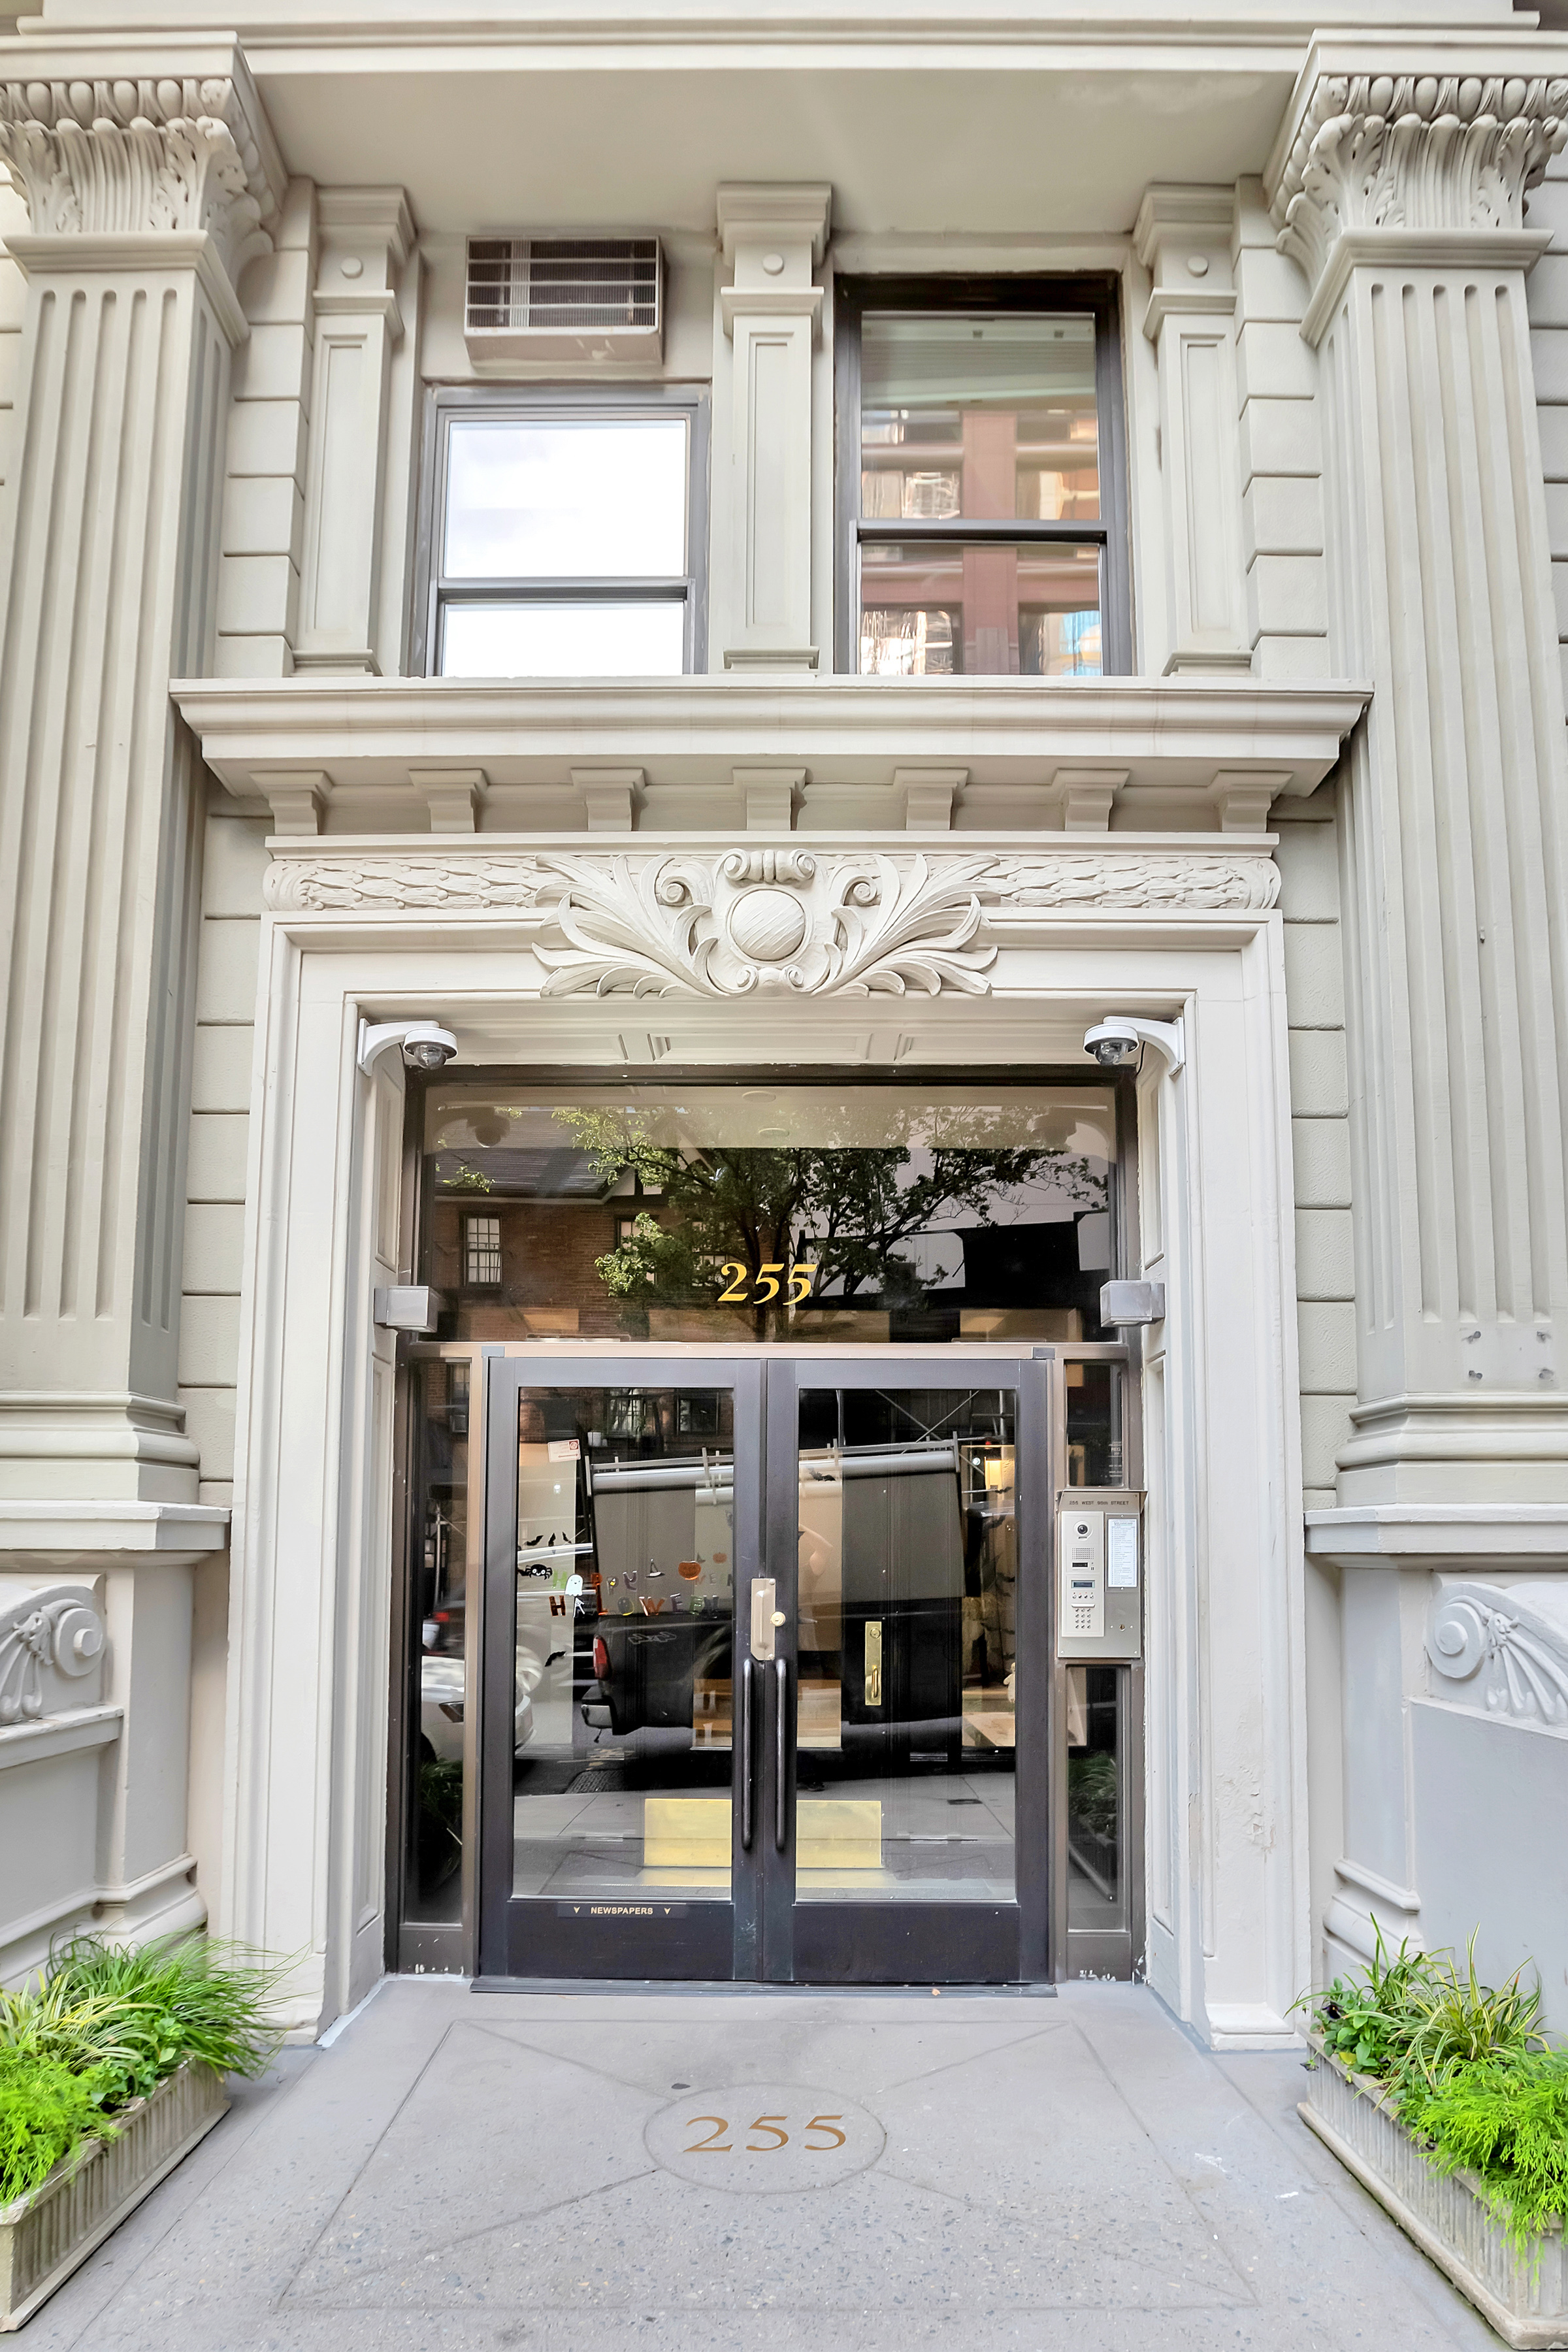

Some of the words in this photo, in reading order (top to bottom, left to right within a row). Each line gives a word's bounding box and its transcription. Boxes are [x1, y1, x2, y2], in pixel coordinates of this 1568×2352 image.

[717, 1262, 818, 1305] 255
[553, 1569, 638, 1595] HPPY
[591, 1906, 653, 1915] NEWSPAPERS
[683, 2115, 847, 2152] 255
